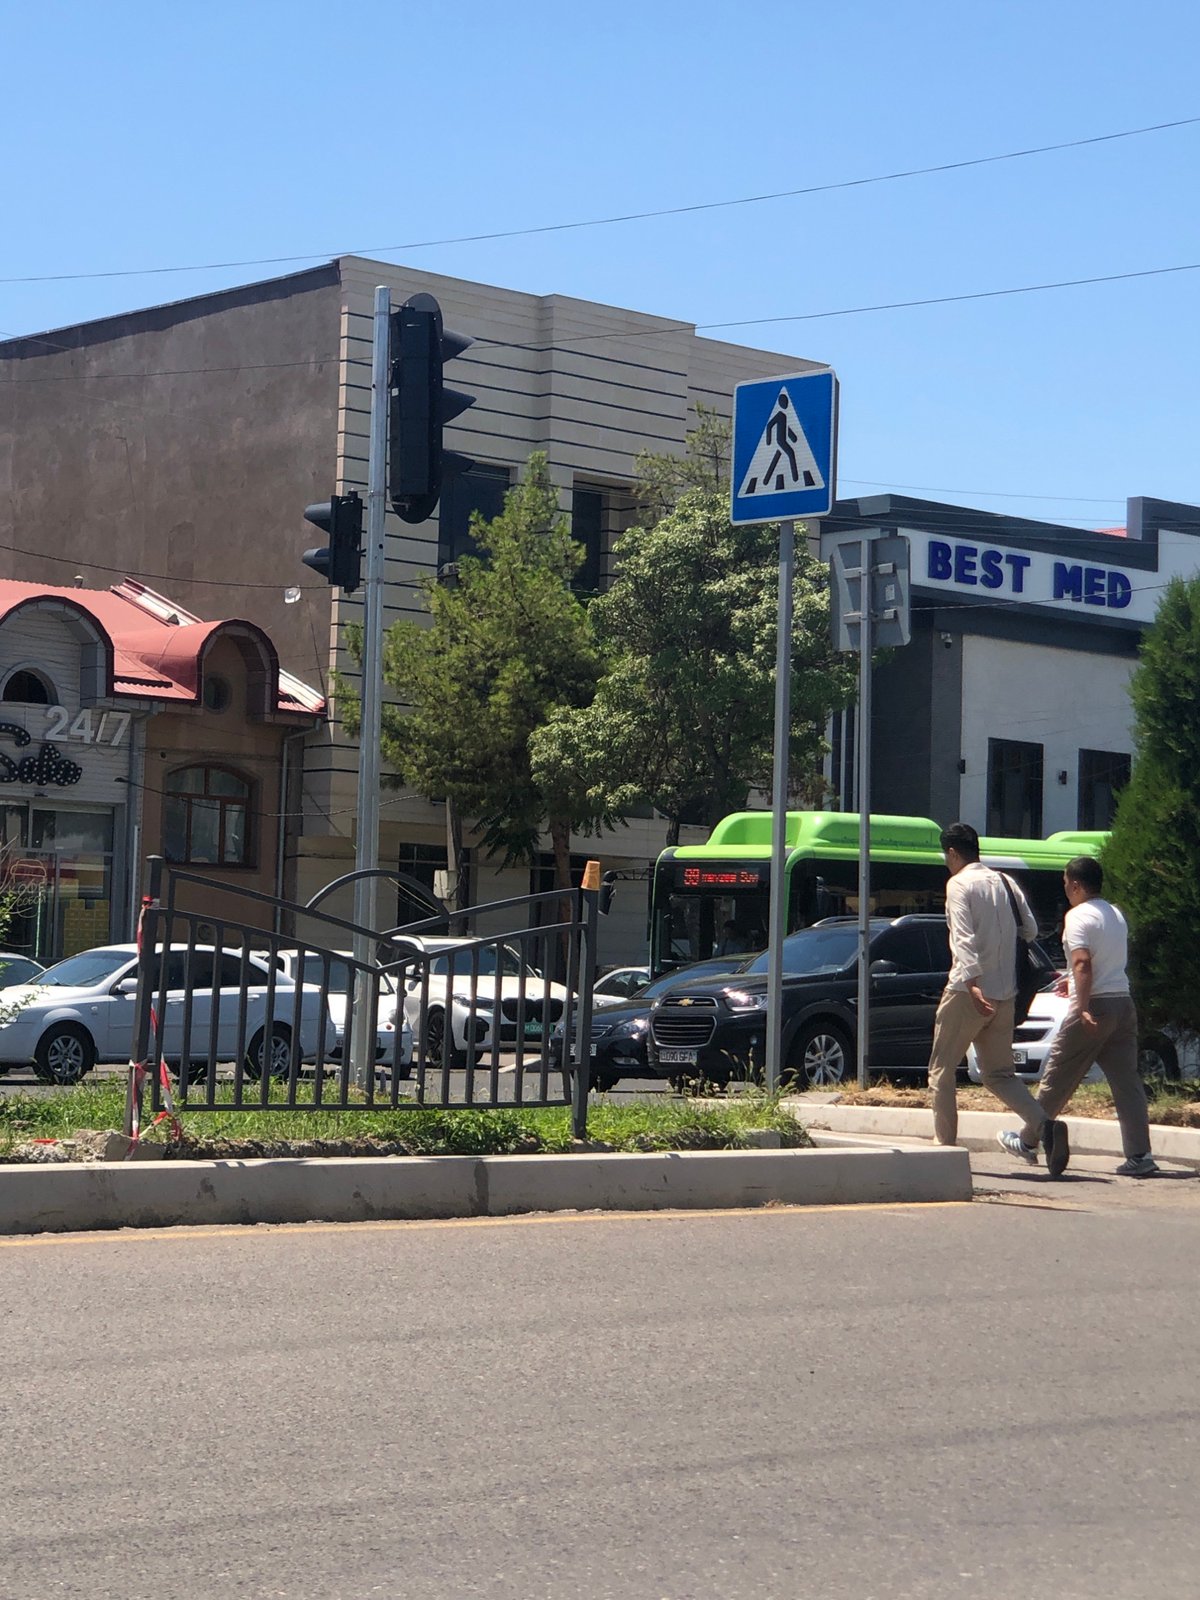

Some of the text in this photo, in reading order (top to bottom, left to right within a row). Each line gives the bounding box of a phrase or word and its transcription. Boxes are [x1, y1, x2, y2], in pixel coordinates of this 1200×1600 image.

[928, 541, 1132, 608] BEST MED
[45, 705, 131, 746] 24/7
